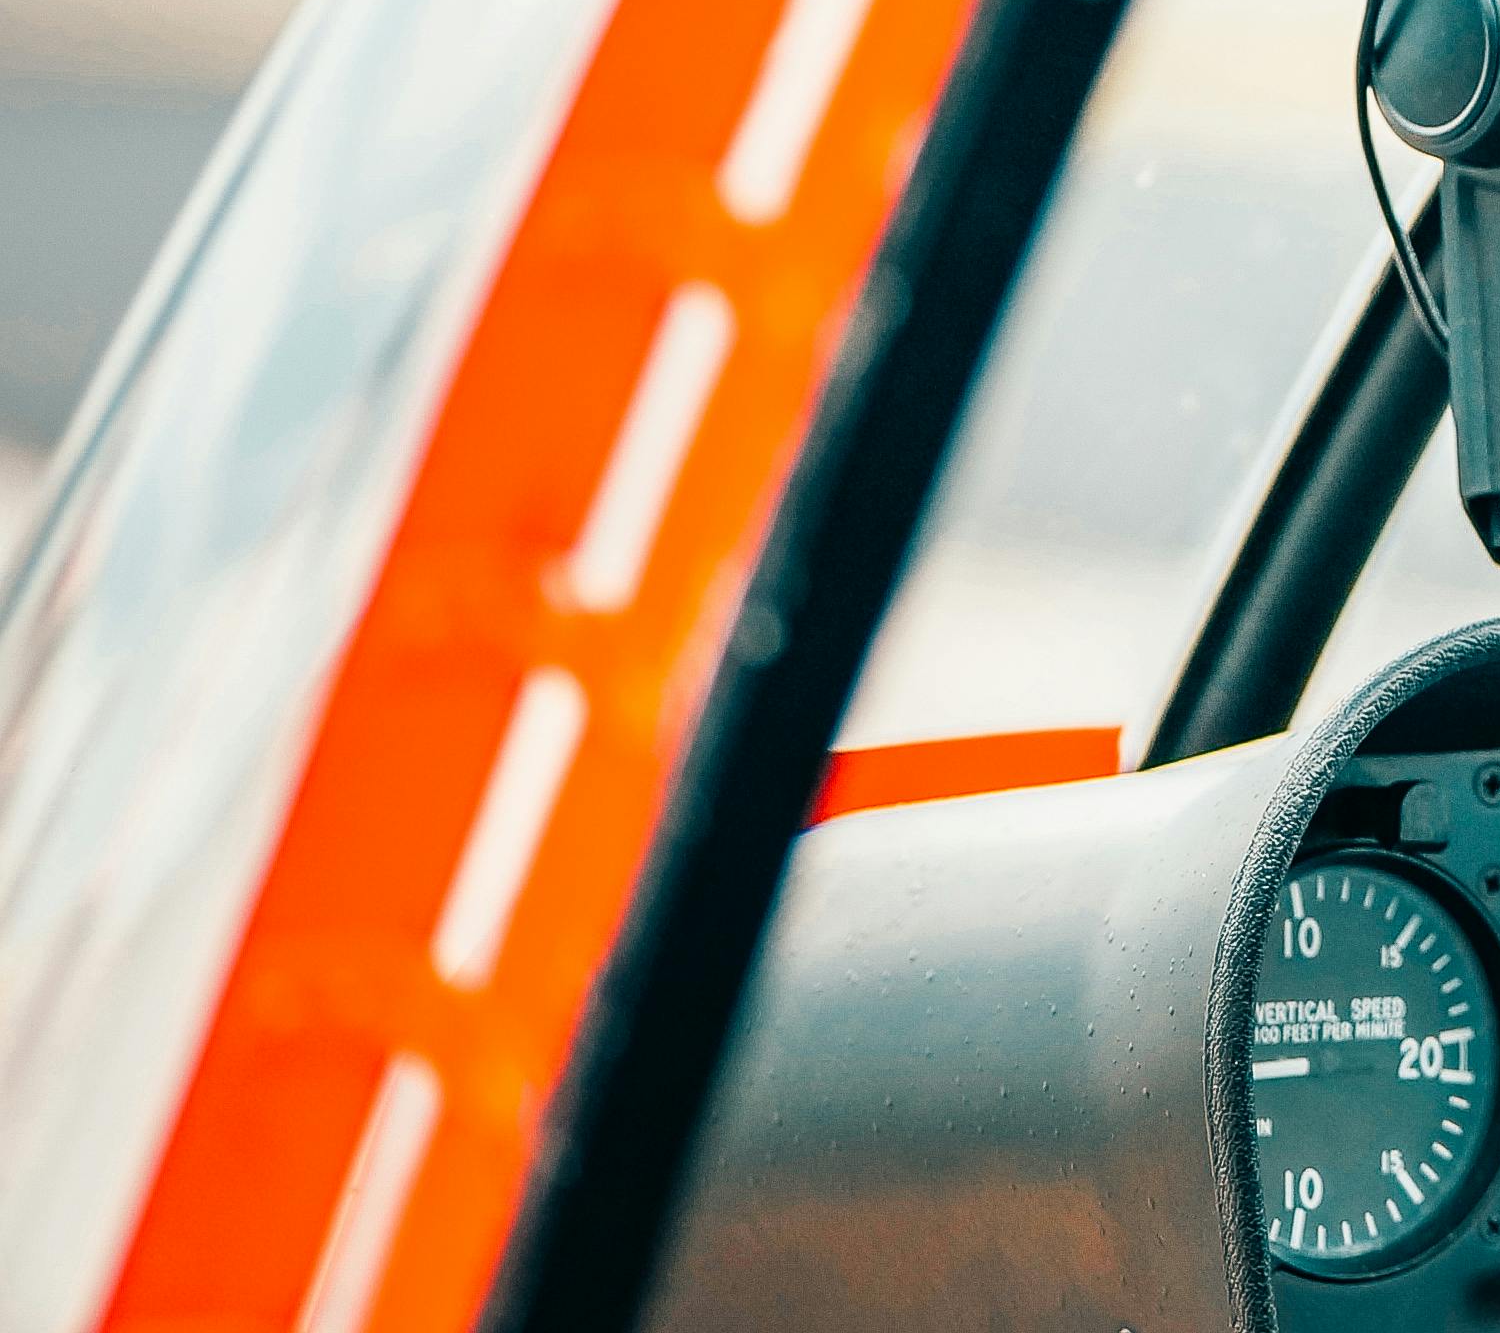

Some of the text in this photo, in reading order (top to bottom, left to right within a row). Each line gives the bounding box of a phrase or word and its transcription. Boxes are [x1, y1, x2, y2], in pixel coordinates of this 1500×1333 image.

[1283, 916, 1323, 960] 10
[1380, 943, 1404, 970] 15
[1254, 995, 1408, 1026] VERTICAL SPEED
[1282, 1022, 1321, 1045] FEET
[1321, 1020, 1354, 1043] PER
[1354, 1017, 1407, 1041] MINUTE
[1397, 1035, 1444, 1081] 20
[1380, 1148, 1404, 1175] 15
[1283, 1167, 1325, 1212] 10
